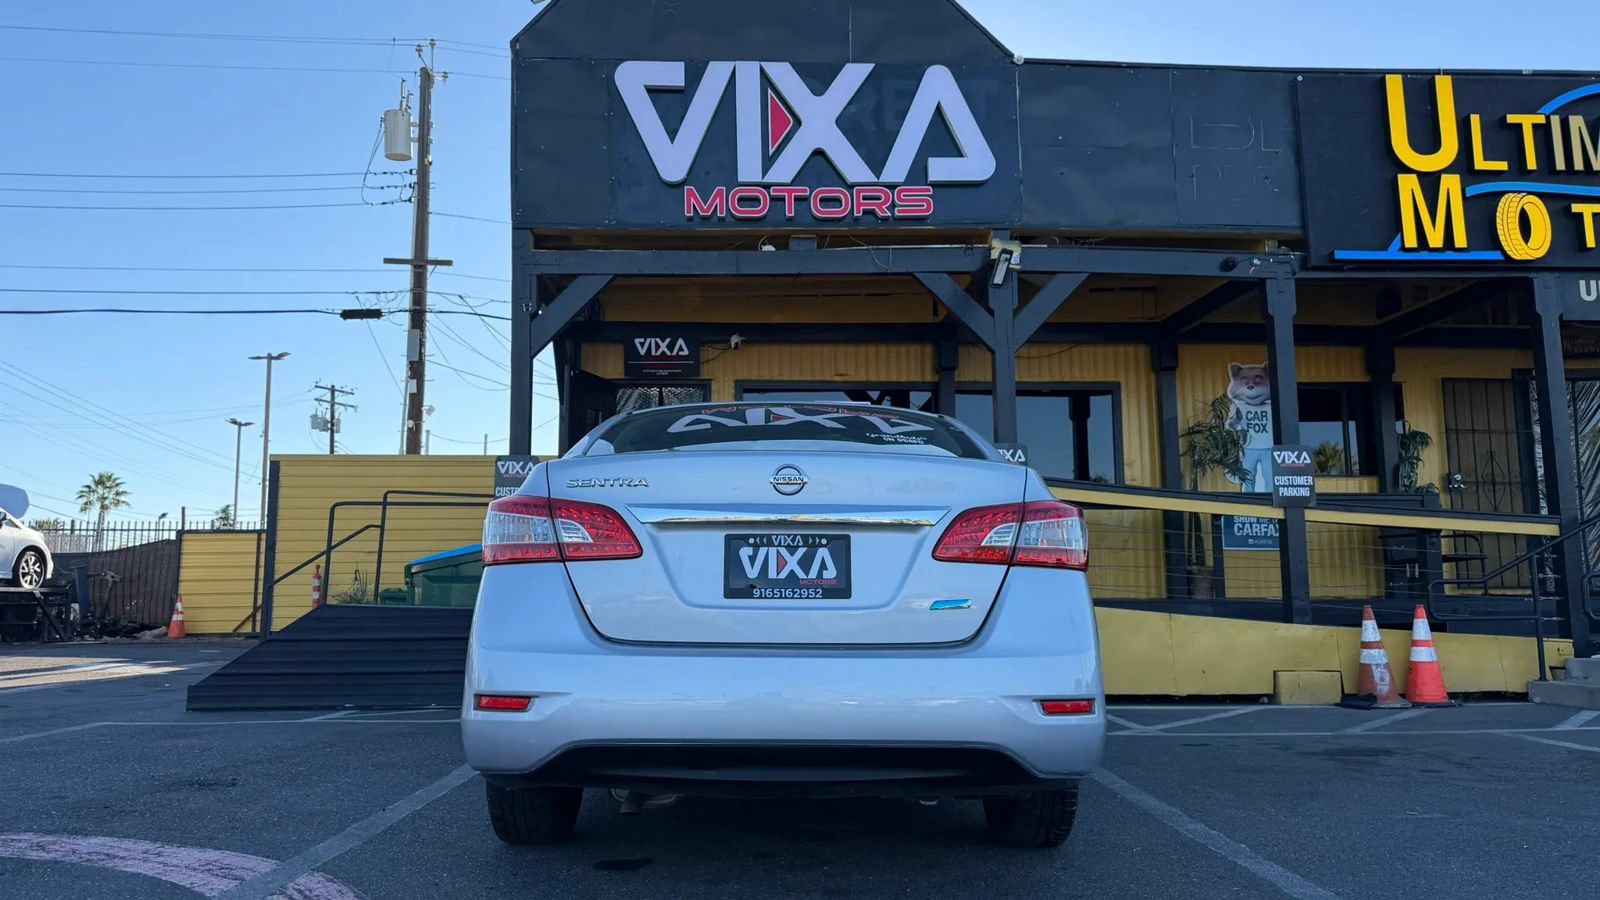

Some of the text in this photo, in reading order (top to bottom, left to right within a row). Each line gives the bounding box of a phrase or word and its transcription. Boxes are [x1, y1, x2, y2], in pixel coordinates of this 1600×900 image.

[614, 60, 997, 185] VIXA
[683, 185, 935, 219] MOTORS
[633, 337, 690, 356] VIXA
[1245, 410, 1269, 422] CAR
[1246, 422, 1269, 434] FOX
[1273, 451, 1312, 464] VIXA
[566, 477, 650, 489] SENTRA
[1274, 475, 1314, 486] CUSTOMER
[1279, 487, 1311, 497] PARKING
[771, 535, 804, 546] VIXA
[738, 546, 838, 579] VIXA
[752, 588, 824, 598] 9165162952
